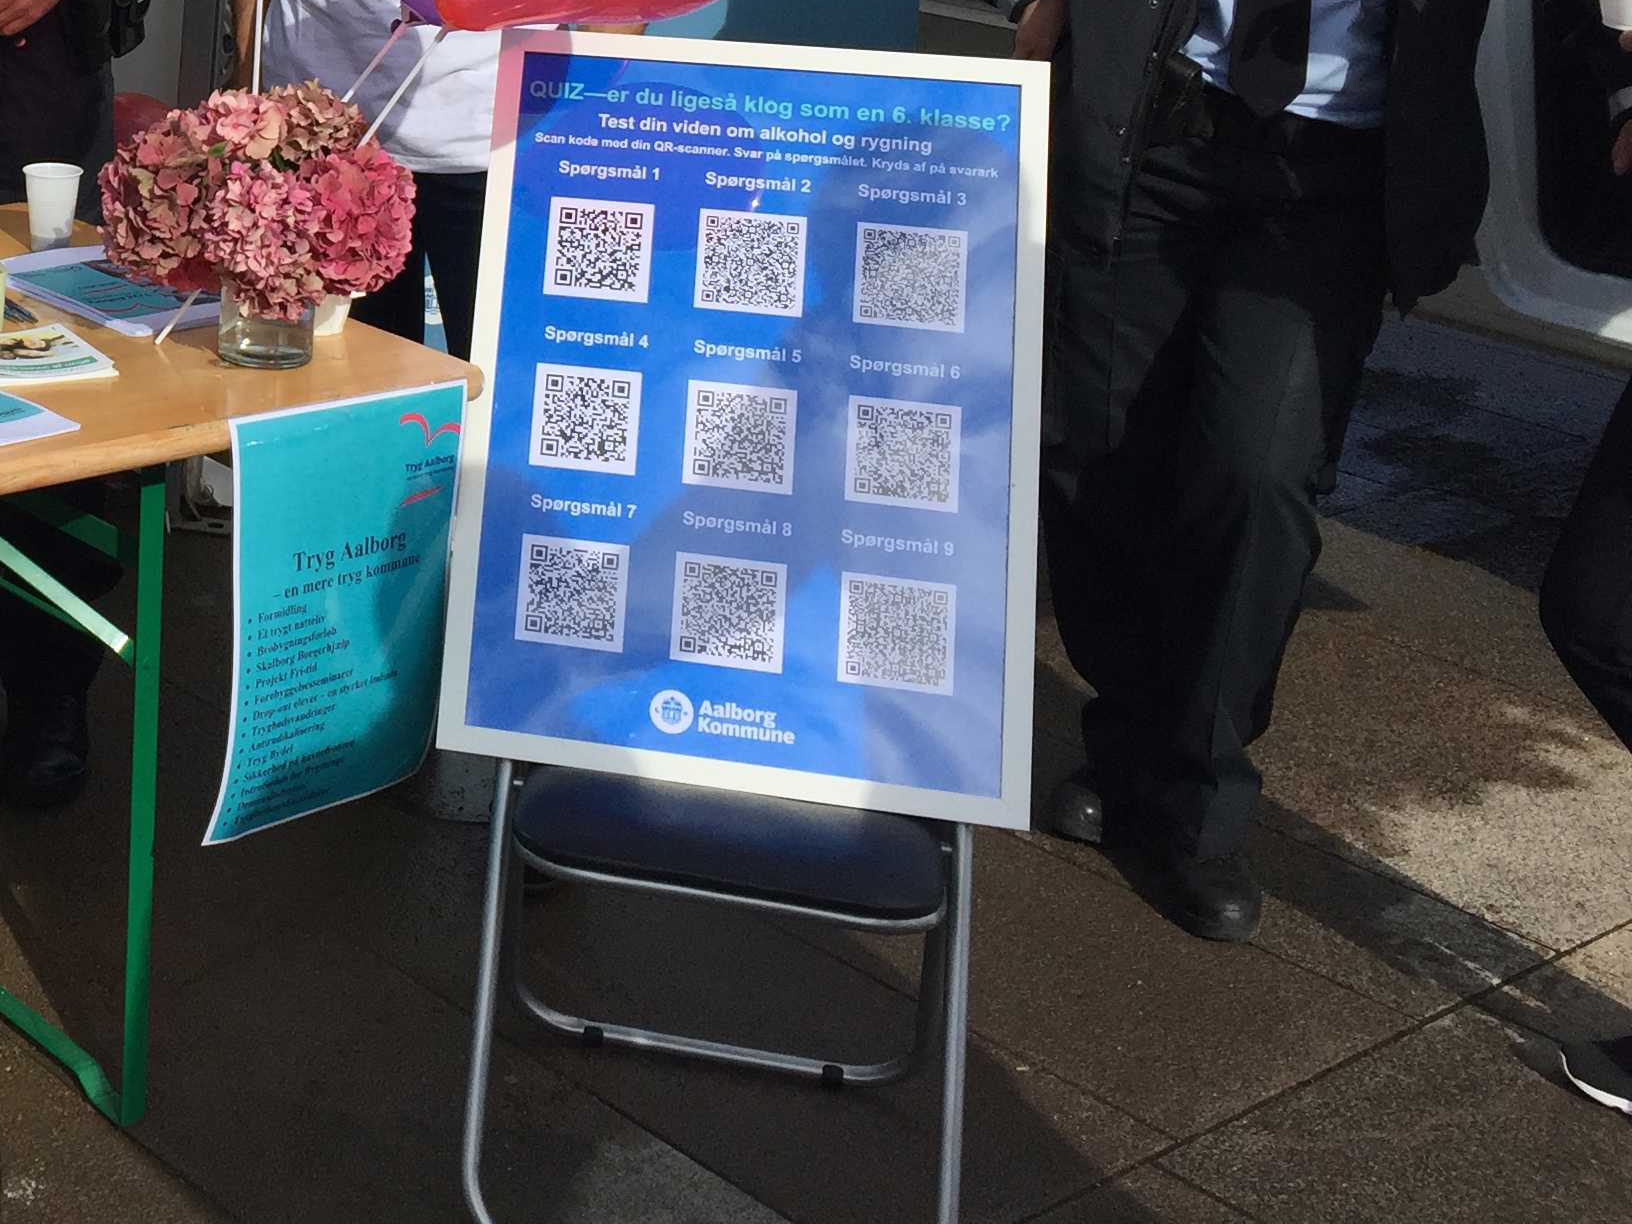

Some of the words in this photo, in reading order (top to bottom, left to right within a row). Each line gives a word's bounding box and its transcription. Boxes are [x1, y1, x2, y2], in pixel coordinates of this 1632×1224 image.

[635, 87, 663, 106] du
[671, 89, 737, 113] ligeså
[744, 95, 793, 119] klog
[799, 102, 850, 120] som
[856, 108, 884, 122] en
[892, 106, 913, 124] 6.
[920, 108, 1012, 132] klasse?
[598, 113, 634, 130] Test
[639, 116, 667, 132] din
[672, 119, 721, 137] viden
[726, 126, 754, 139] om
[759, 126, 827, 145] alkohol
[832, 134, 856, 150] og
[860, 135, 934, 157] rygning
[534, 132, 565, 144] Scan
[568, 133, 599, 147] kode
[601, 137, 629, 150] med
[631, 139, 651, 152] din
[653, 140, 732, 157] QR-scanner.
[734, 147, 764, 160] Svar
[766, 148, 783, 163] på
[871, 157, 910, 172] Kryds
[913, 162, 926, 173] af
[929, 163, 946, 176] på
[559, 160, 646, 180] Spørgsmål
[651, 167, 661, 181] 1
[705, 171, 796, 192] Spørgsmål
[800, 179, 812, 193] 2
[858, 184, 952, 205] Spørgsmål
[957, 192, 967, 206] 3
[544, 325, 634, 347] Spørgsmål
[638, 335, 649, 349] 4
[694, 339, 787, 362] Spørgsmål
[792, 349, 802, 364] 5
[849, 355, 946, 379] Spørgsmål
[950, 365, 961, 380] 6
[530, 493, 623, 517] Spørgsmål
[627, 504, 637, 519] 7
[683, 511, 777, 535] Spørgsmål
[782, 522, 792, 537] 8
[293, 549, 336, 573] Tryg
[340, 531, 407, 561] Aalborg
[841, 528, 940, 555] Spørgsmål
[944, 541, 954, 556] 9
[284, 585, 299, 600] en
[302, 576, 333, 596] mere
[337, 565, 363, 588] tryg
[366, 553, 422, 578] kommune
[257, 603, 308, 624] Formidling
[699, 700, 777, 728] Aalborg
[697, 716, 796, 745] Kommune
